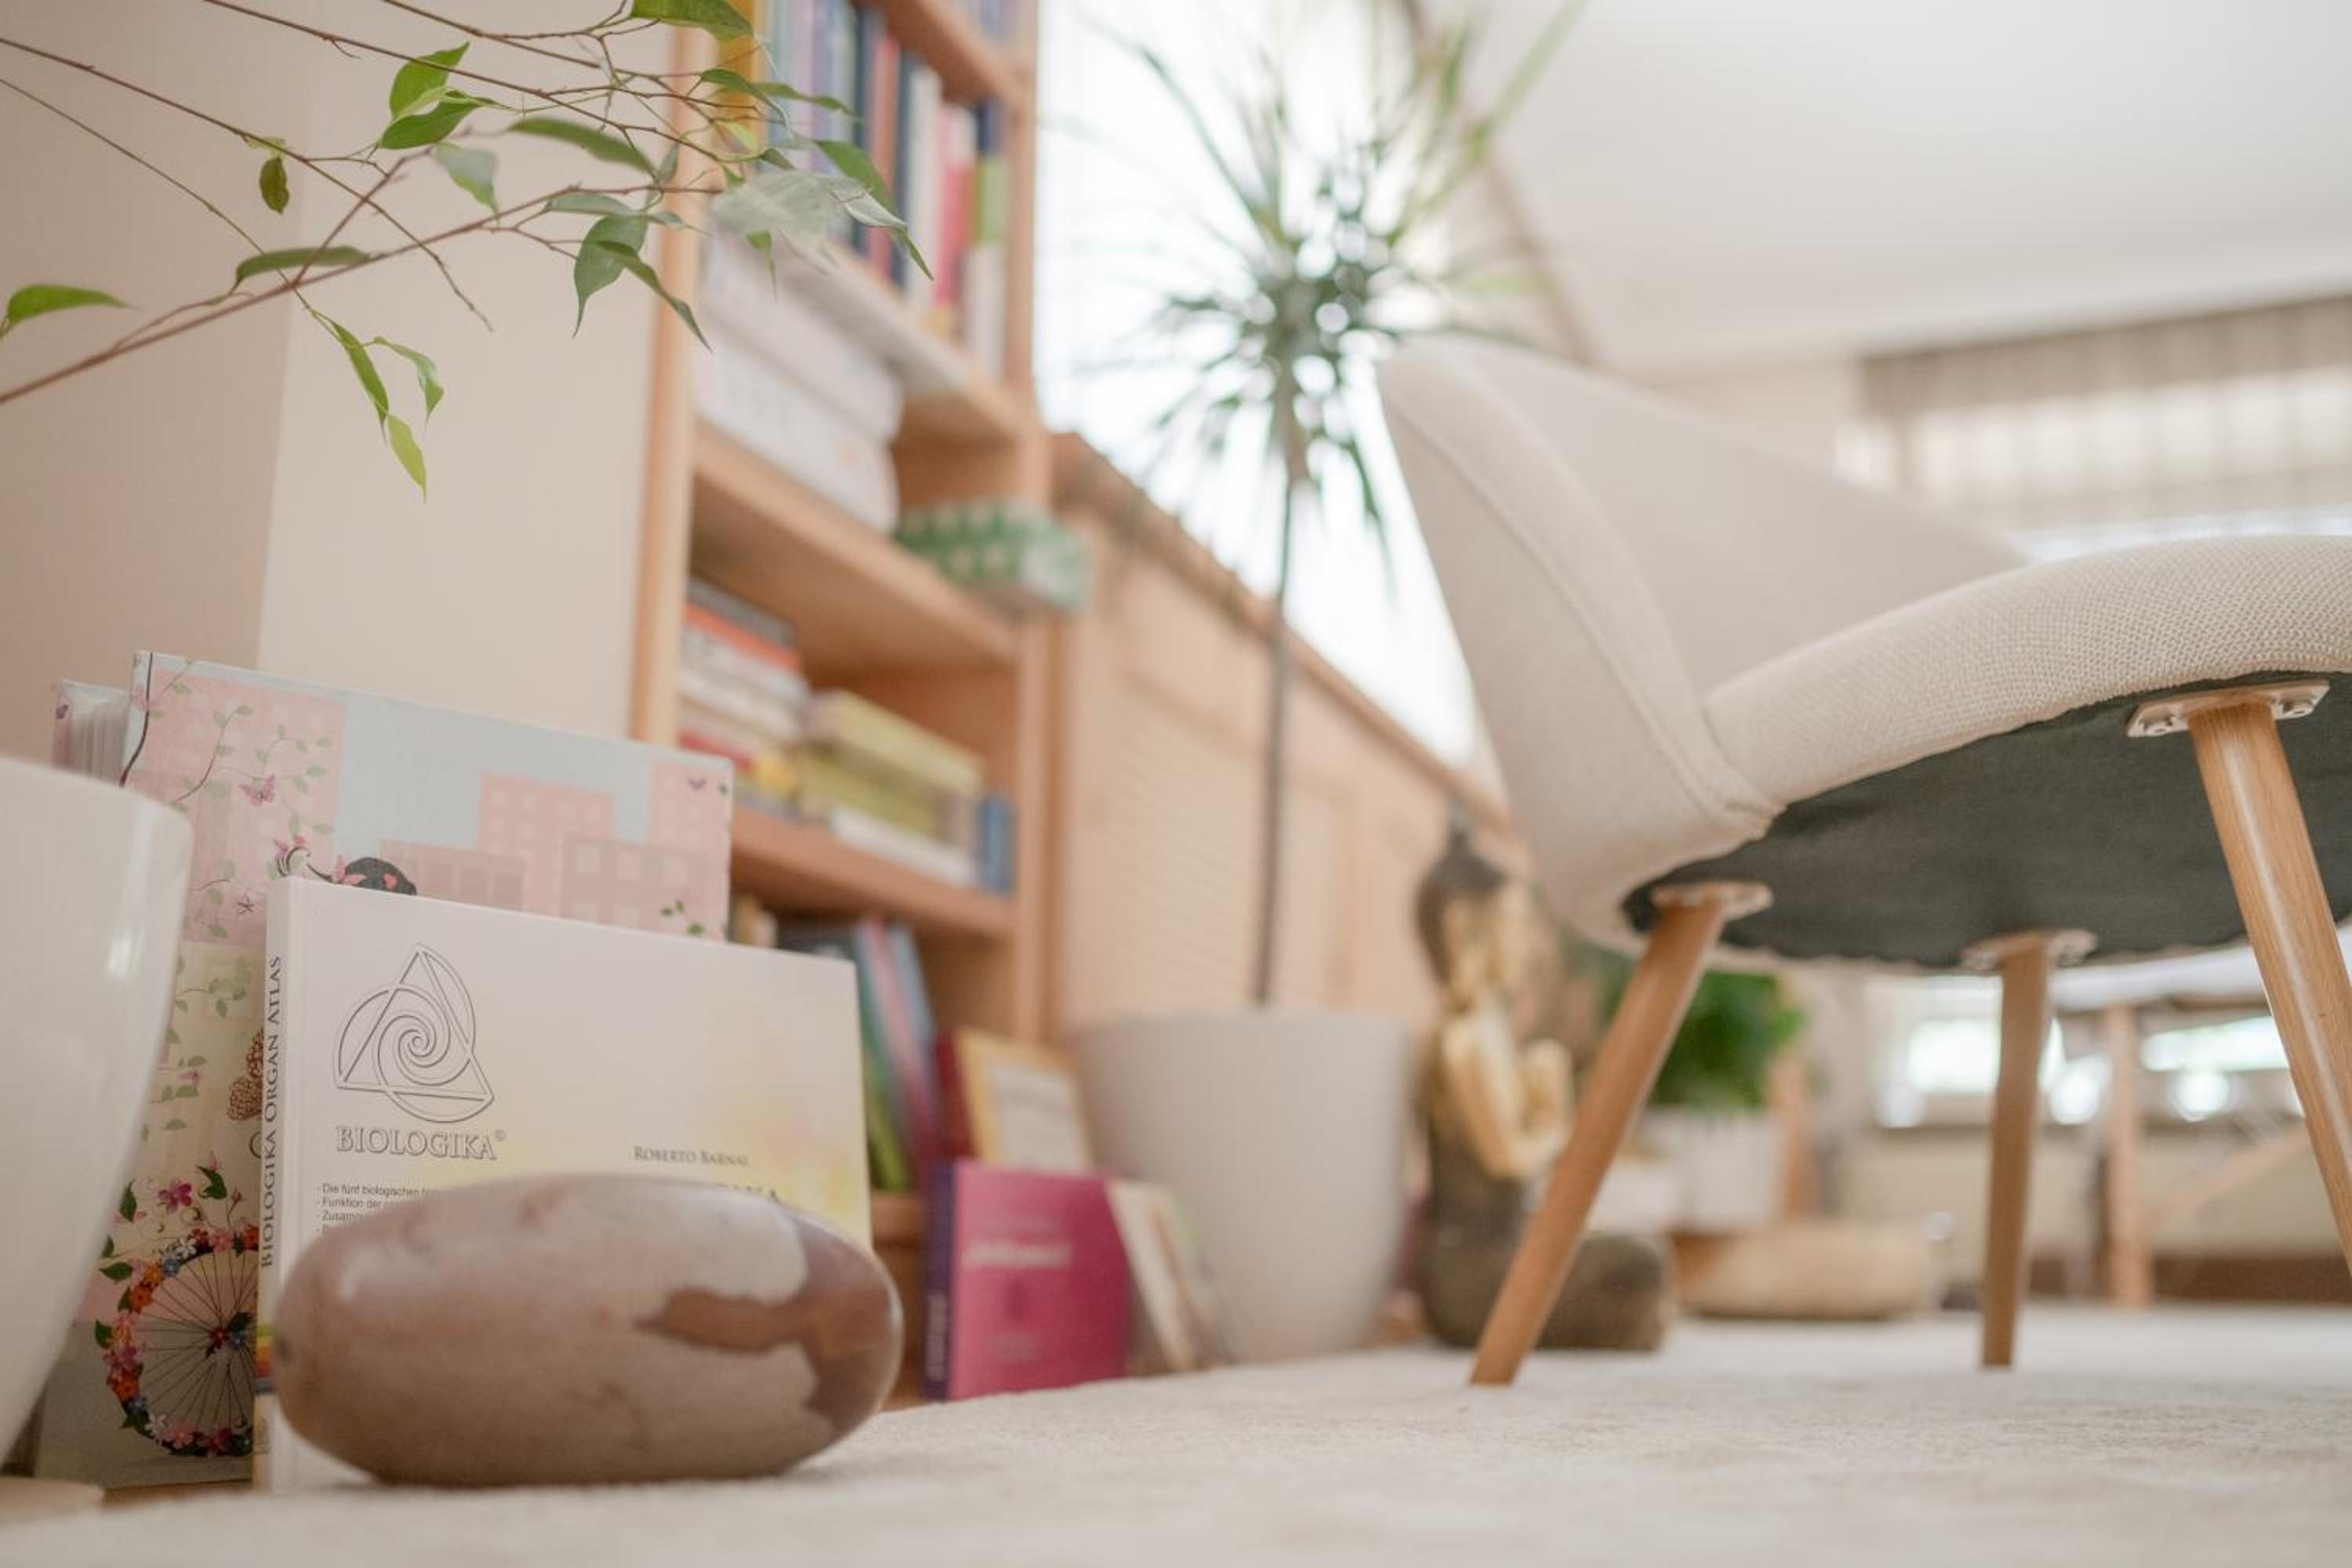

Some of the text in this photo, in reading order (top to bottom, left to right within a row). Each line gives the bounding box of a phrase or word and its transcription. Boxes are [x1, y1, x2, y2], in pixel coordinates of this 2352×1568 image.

[261, 956, 281, 1268] BIOLOGIKA ORGAN ATLAS
[322, 1182, 339, 1193] Die
[361, 1184, 419, 1197] biologischen
[322, 1196, 363, 1207] Funktion
